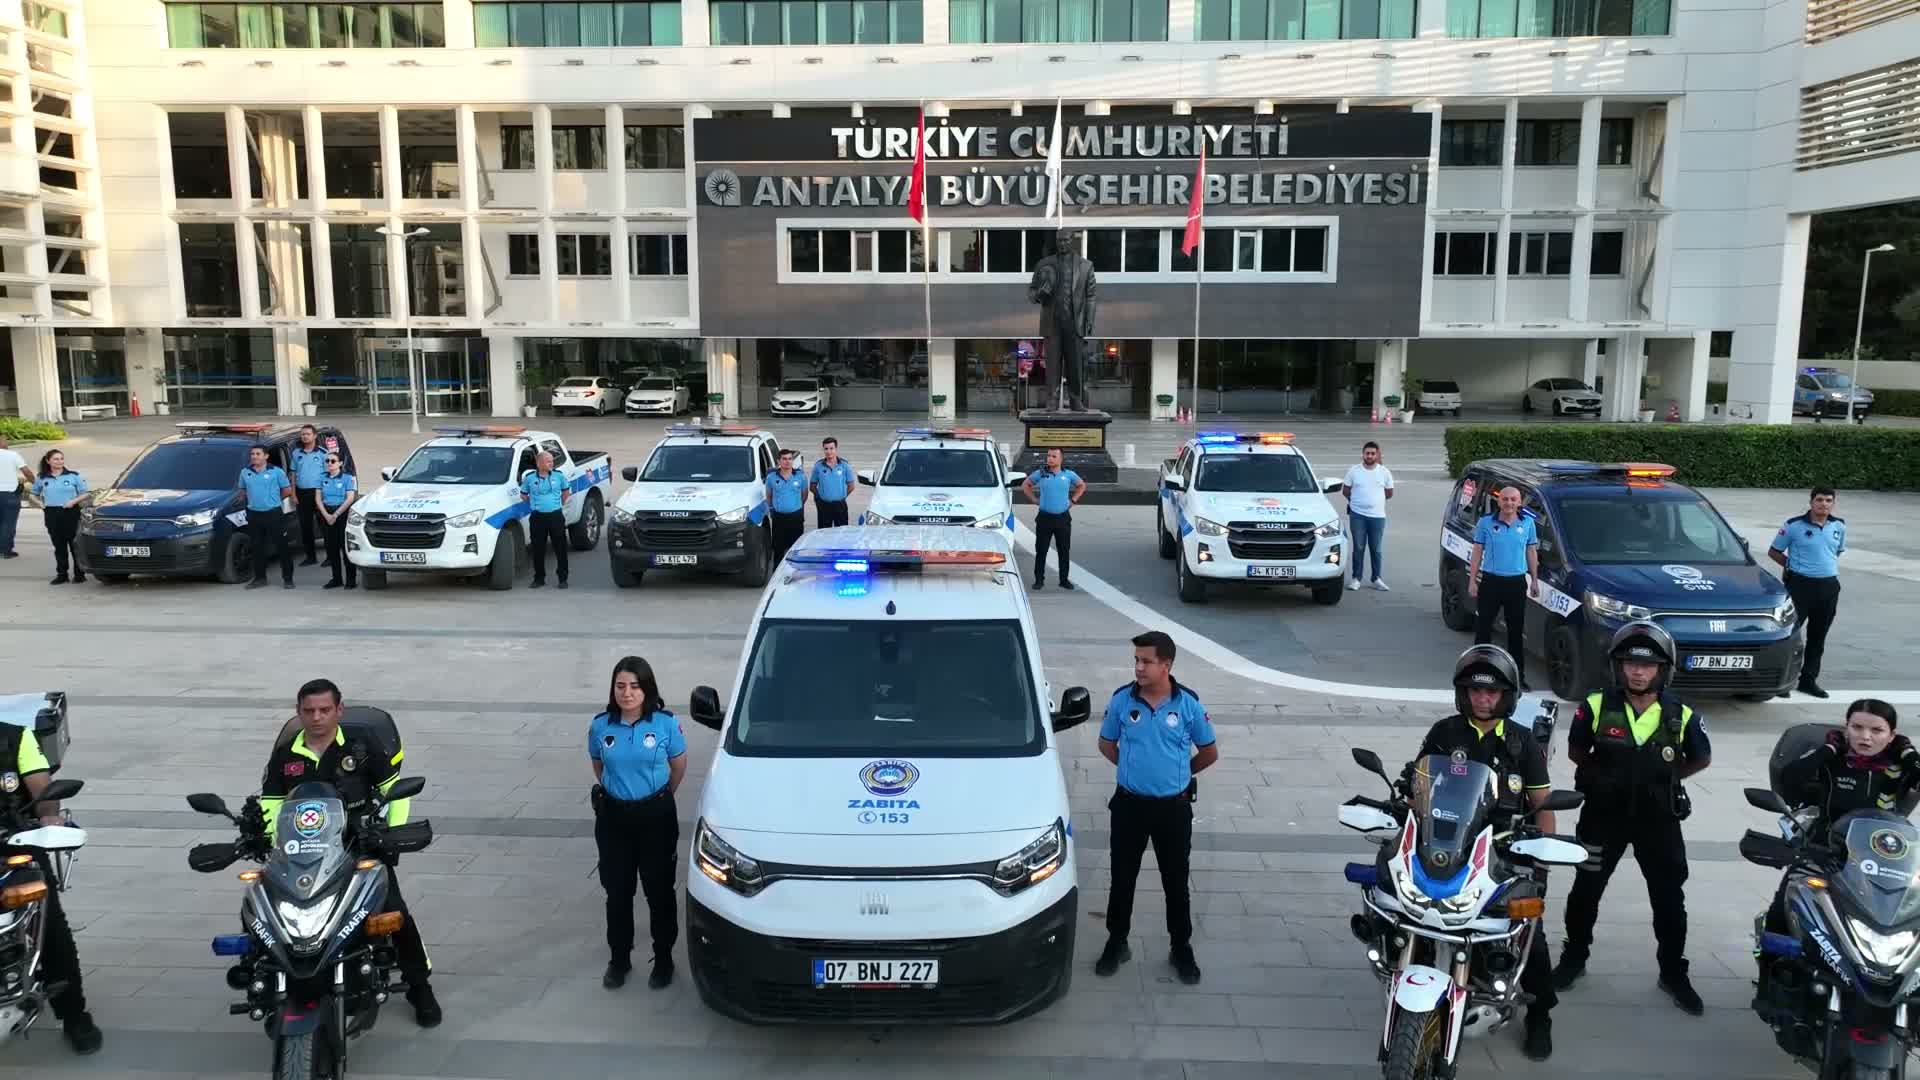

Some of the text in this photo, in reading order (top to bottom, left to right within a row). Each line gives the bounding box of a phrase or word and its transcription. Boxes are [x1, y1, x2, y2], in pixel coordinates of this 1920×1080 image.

[831, 118, 998, 159] TÜRKİYE
[1204, 164, 1420, 205] BELEDİYESİ
[384, 553, 394, 561] 34
[396, 553, 409, 561] KTC
[1251, 567, 1261, 576] 34
[1265, 567, 1280, 576] KTC
[1555, 594, 1570, 613] 153
[1709, 620, 1727, 632] FIAT
[1693, 656, 1751, 667] 07 BNJ 273
[847, 799, 920, 808] ZABITA
[879, 812, 909, 823] 153
[1809, 929, 1842, 963] ZABITA
[825, 962, 847, 981] 07
[857, 962, 892, 981] BNJ
[899, 962, 933, 981] 227
